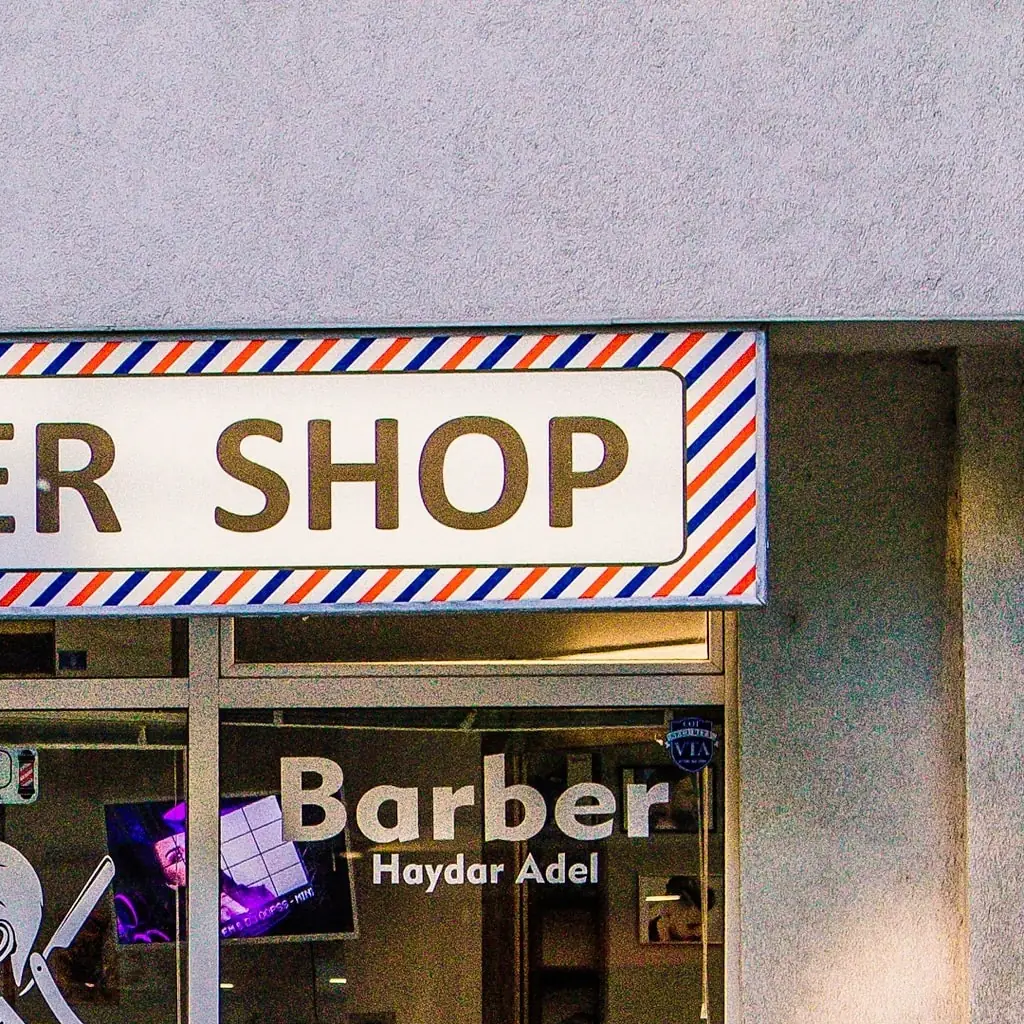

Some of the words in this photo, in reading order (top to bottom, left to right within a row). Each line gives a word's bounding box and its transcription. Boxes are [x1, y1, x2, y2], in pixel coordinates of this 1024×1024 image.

[213, 415, 630, 533] SHOP
[279, 752, 670, 844] Barber
[372, 852, 505, 893] Haydar
[514, 852, 599, 885] Adel
